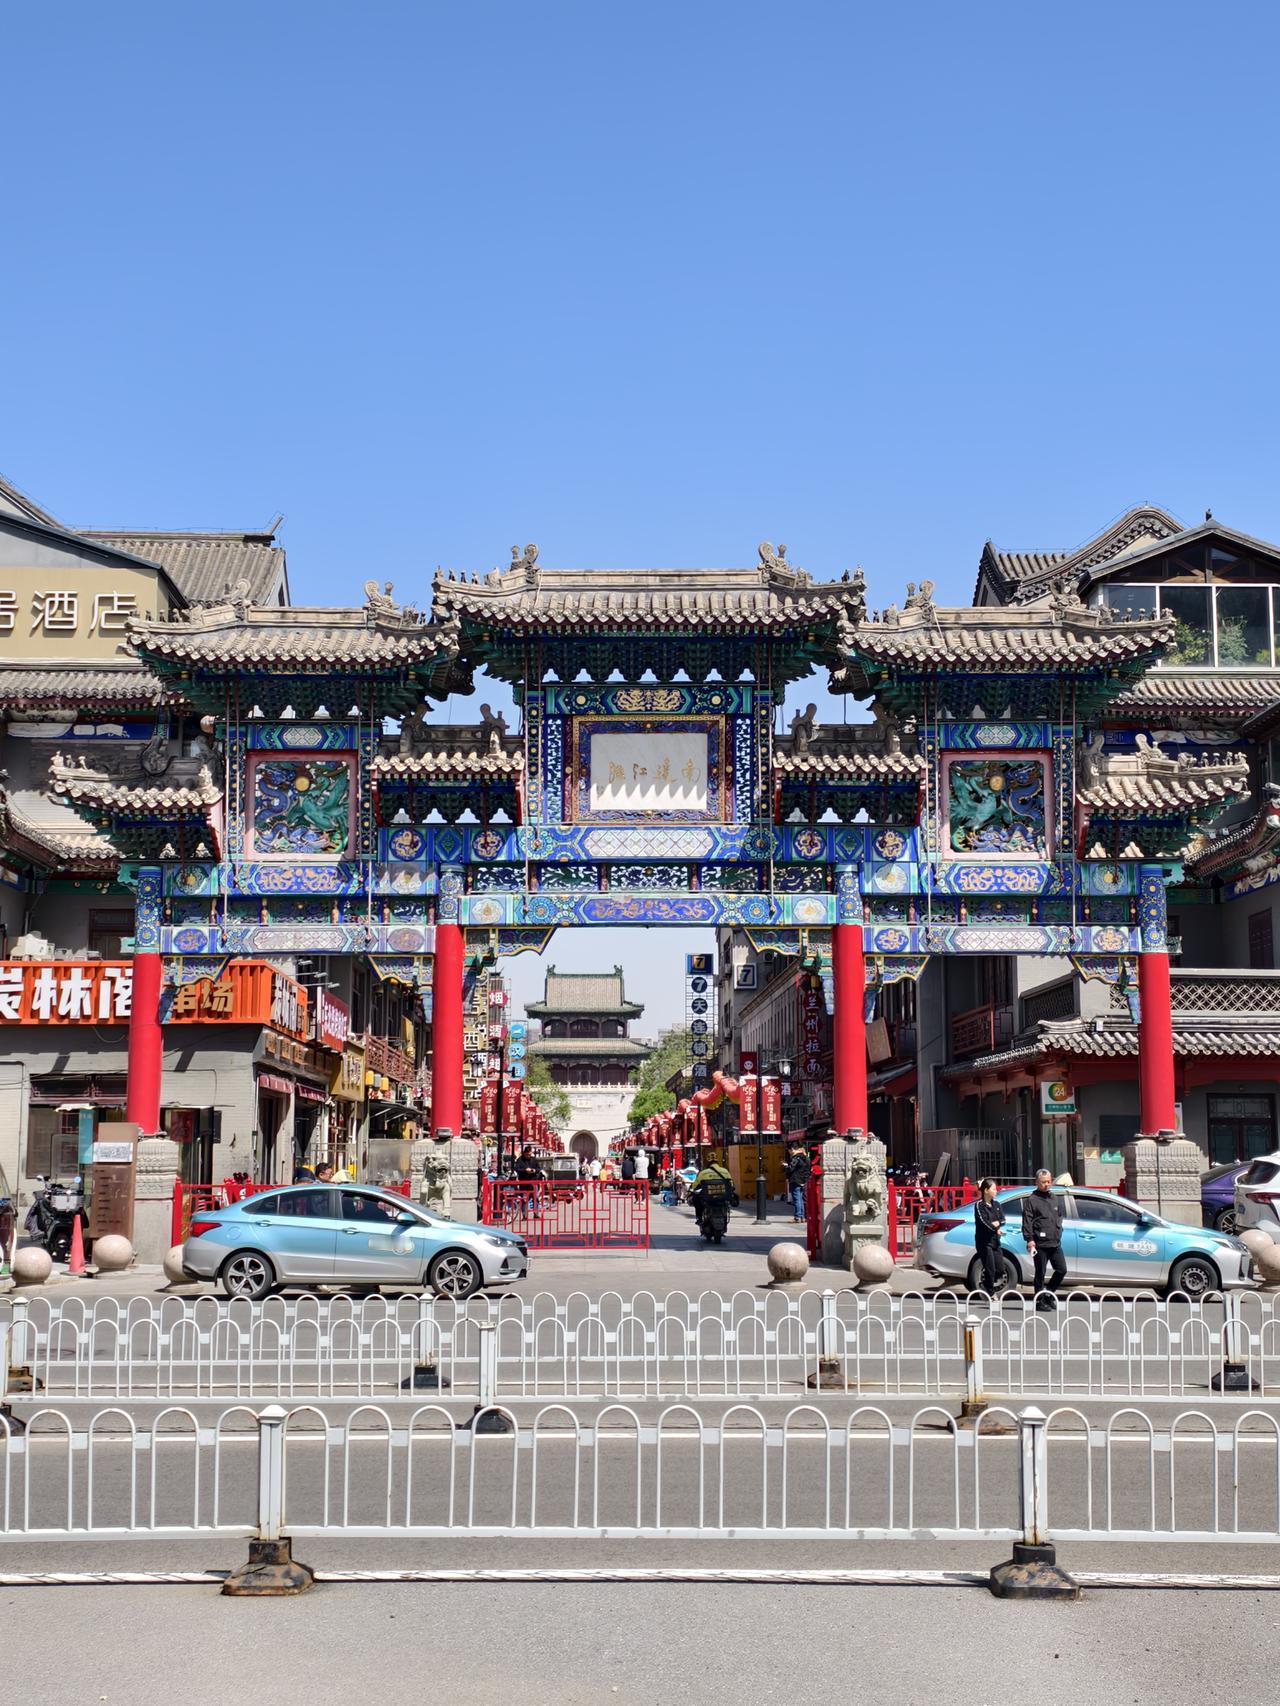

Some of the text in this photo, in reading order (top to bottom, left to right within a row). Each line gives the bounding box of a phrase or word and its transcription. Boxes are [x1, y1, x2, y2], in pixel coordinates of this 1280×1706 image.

[740, 968, 751, 982] 7
[693, 979, 707, 1092] 7天连锁酒
[805, 991, 821, 1075] 兰州拉面
[1055, 1087, 1065, 1097] 24
